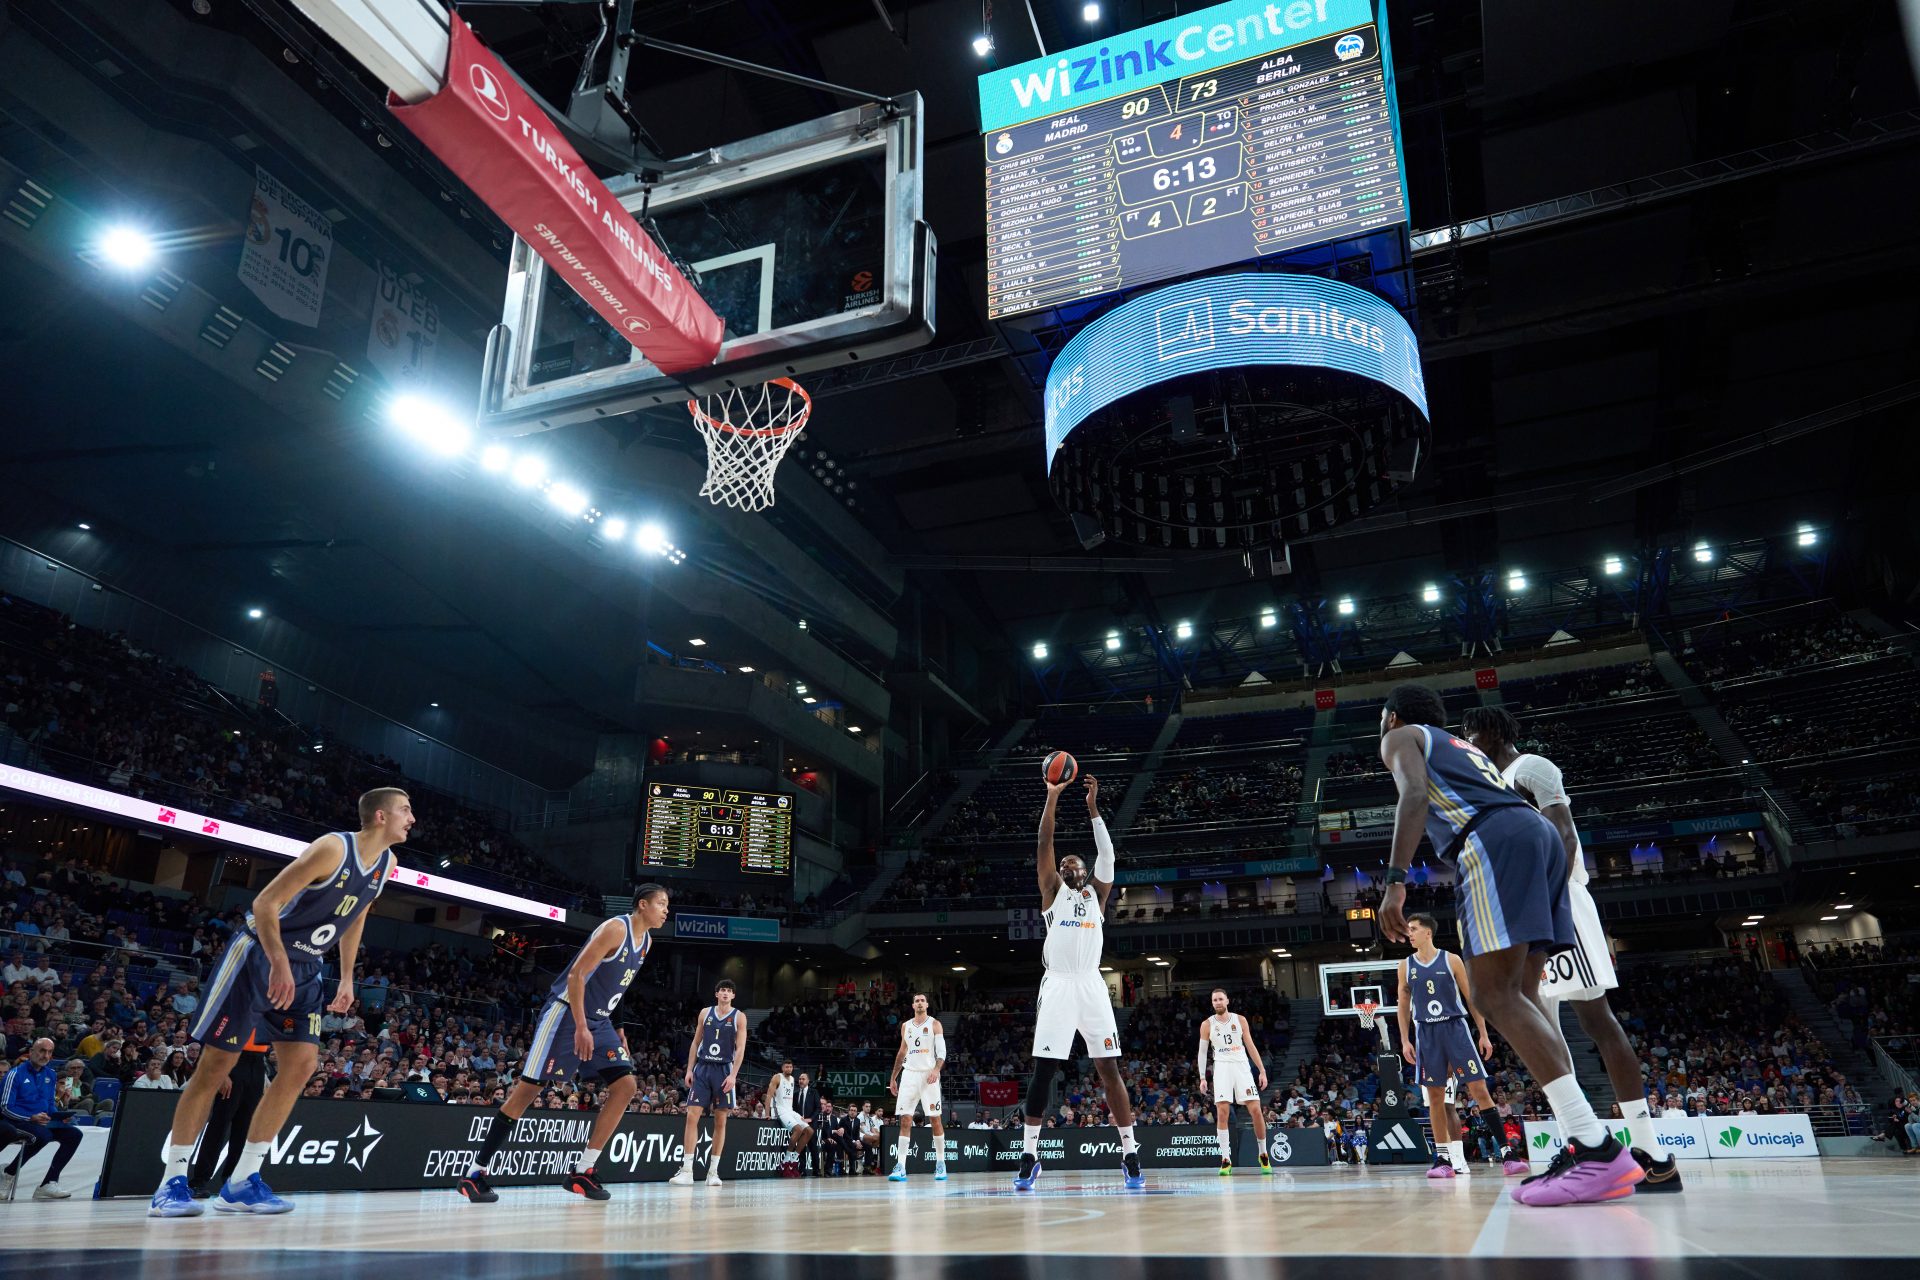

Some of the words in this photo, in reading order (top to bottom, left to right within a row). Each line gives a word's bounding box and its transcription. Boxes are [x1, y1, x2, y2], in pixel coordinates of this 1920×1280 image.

[1261, 55, 1293, 71] ALBA
[1256, 65, 1301, 84] BERLIN
[1190, 79, 1218, 102] 73
[1258, 88, 1285, 100] ISRAEL
[1287, 76, 1330, 92] GONZALEZ
[1121, 97, 1150, 120] 90
[1259, 98, 1297, 112] PROCIDA,
[1051, 114, 1080, 129] REAL
[1216, 110, 1232, 121] TO
[1261, 108, 1306, 124] SPAGNOLO,
[1169, 124, 1183, 140] 4
[1263, 121, 1300, 136] WETZELL,
[1302, 114, 1327, 126] YANNI
[1044, 124, 1088, 143] MADRID
[1120, 137, 1135, 146] TO
[1264, 136, 1294, 148] DELOW,
[1265, 148, 1294, 160] NUFER,
[1296, 140, 1324, 153] ANTON
[999, 160, 1018, 170] CHUS
[1020, 155, 1044, 166] MATEO
[1266, 156, 1319, 173] MATTISSECK,
[1000, 170, 1029, 182] ABALDE,
[1153, 156, 1217, 191] 6:13
[1268, 169, 1316, 185] SCHNEIDER,
[258, 180, 278, 200] DE
[1000, 180, 1040, 194] CAMPAZZO,
[1270, 186, 1300, 198] SAMAR,
[518, 114, 598, 215] TURKISH
[602, 210, 673, 292] AIRLINES
[1000, 186, 1056, 205] RATHAN-MAYES,
[1202, 197, 1217, 216] 2
[1226, 186, 1240, 197] FT
[1271, 195, 1314, 211] DOERRIES,
[1316, 188, 1341, 200] AMON
[1000, 202, 1039, 217] GONZALEZ,
[1041, 197, 1062, 207] HUGO
[1273, 207, 1316, 224] RAPIEQUE,
[1318, 200, 1342, 212] ELIAS
[1001, 216, 1035, 228] HEZONJA,
[1126, 211, 1139, 221] FT
[1147, 211, 1162, 228] 4
[1274, 220, 1317, 236] WILLIAMS,
[1318, 213, 1348, 226] TREVIO
[1001, 231, 1023, 240] MUSA,
[275, 227, 314, 276] 10
[534, 222, 586, 270] AIRLINES
[1002, 243, 1023, 252] DECK,
[1002, 255, 1025, 264] IBAKA,
[1002, 264, 1037, 276] TAVARES,
[1002, 279, 1026, 289] LLULL,
[581, 271, 628, 315] TURKISH
[844, 288, 880, 302] TURKISH
[1003, 292, 1024, 302] FELIZ,
[380, 279, 438, 334] ULEB
[844, 296, 880, 309] AIRLINES
[1003, 303, 1031, 314] NDIAYE,
[1226, 300, 1386, 354] Sanitas
[10, 772, 38, 790] QUE
[39, 779, 81, 800] MEJOR
[82, 789, 120, 809] SUENA
[710, 825, 733, 835] 6:13
[334, 894, 358, 917] 10
[1073, 903, 1086, 918] 18
[1545, 955, 1574, 984] 30
[1427, 980, 1435, 995] 3
[715, 1029, 720, 1040] 1
[915, 1037, 921, 1047] 6
[1224, 1034, 1232, 1044] 13
[1468, 1060, 1477, 1075] 3
[826, 1073, 881, 1086] SALIDA
[726, 1092, 731, 1104] 1
[838, 1086, 864, 1096] EXIT
[1445, 1086, 1452, 1098] 4
[935, 1102, 941, 1111] 6
[757, 1127, 791, 1146] DEPORTES
[1171, 1136, 1201, 1145] DEPORTES
[1747, 1132, 1804, 1148] Unicaja
[609, 1132, 684, 1172] OlyTV.e
[1041, 1151, 1065, 1160] PRIMERA
[1156, 1147, 1196, 1157] EXPERIENCIAS
[1197, 1147, 1206, 1156] DE
[520, 1151, 538, 1175] DE
